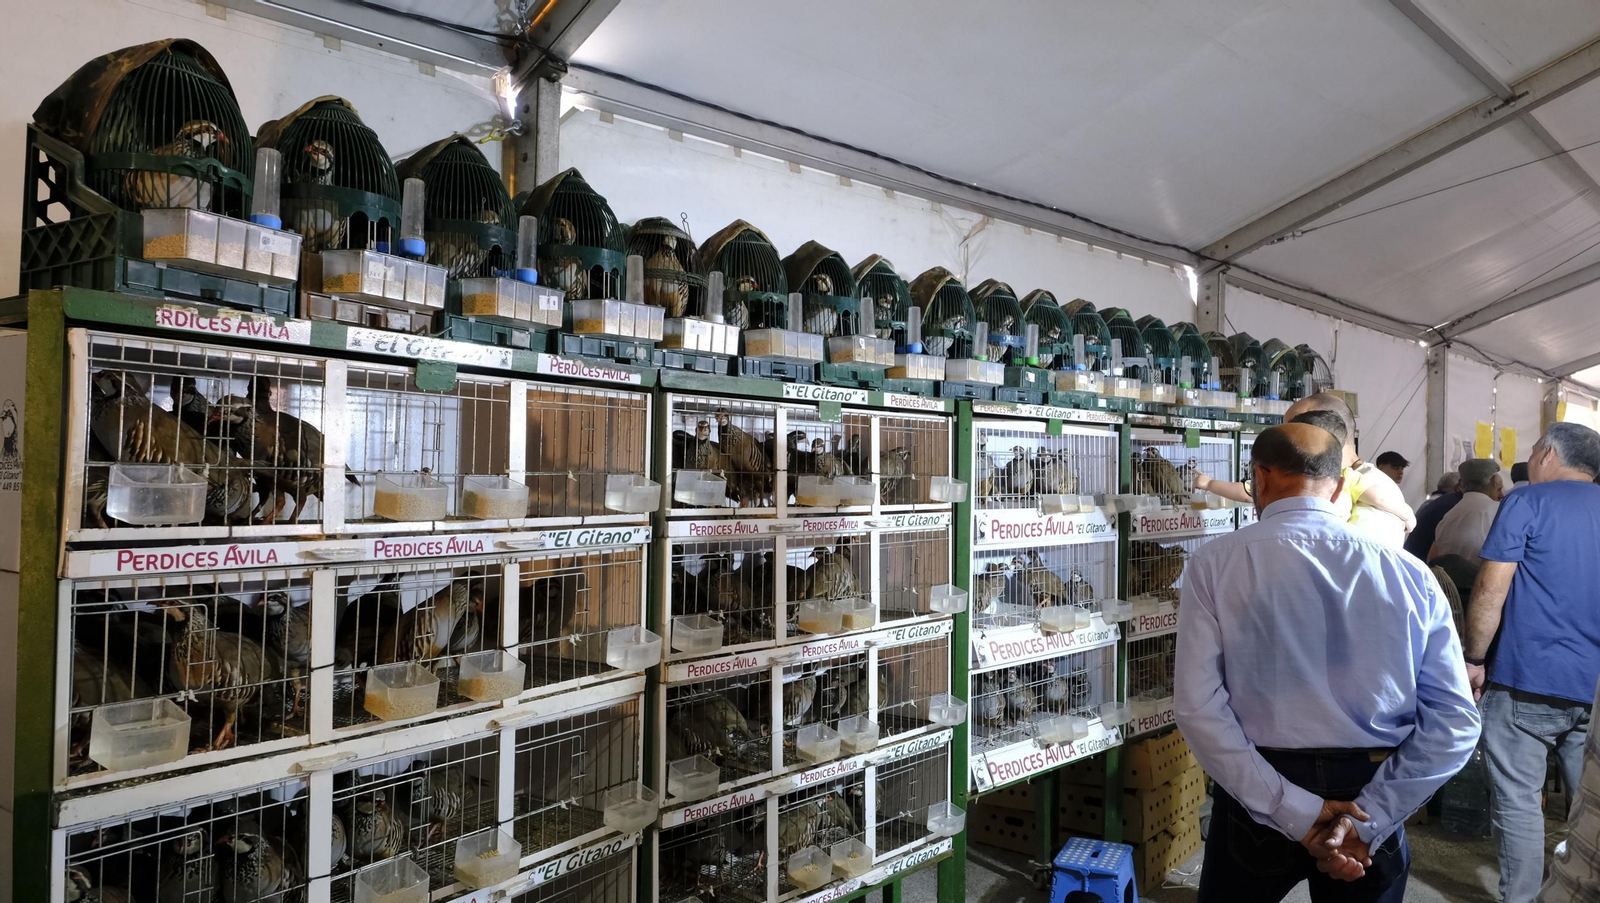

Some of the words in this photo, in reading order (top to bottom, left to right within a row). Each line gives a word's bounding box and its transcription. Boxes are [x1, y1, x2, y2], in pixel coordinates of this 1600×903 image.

[549, 356, 600, 378] PERDICES
[791, 385, 809, 399] "El
[812, 387, 858, 402] Gitano"
[890, 394, 920, 409] PERDICES
[1032, 405, 1044, 417] "El
[1045, 407, 1076, 420] Gitano"
[1184, 419, 1206, 429] Gitano"
[689, 521, 733, 536] PERDICES
[734, 520, 759, 534] ÁVILA
[802, 519, 838, 532] PERDICES
[838, 517, 859, 530] ÁVILA
[891, 515, 906, 527] "El
[907, 513, 945, 527] Gitano"
[991, 518, 1043, 540] PERDICES
[1044, 515, 1074, 536] ÁVILA
[1075, 523, 1085, 535] "El
[1085, 521, 1109, 534] Gitano"
[1140, 515, 1179, 534] PERDICES
[1180, 512, 1202, 529] ÁVILA
[1209, 516, 1229, 528] Gitano"
[373, 538, 443, 559] PERDICES
[445, 535, 485, 554] ÁVILA
[548, 529, 572, 548] "El
[576, 527, 640, 546] Gitano"
[116, 548, 219, 572] PERDICES
[223, 544, 279, 566] ÁVILA
[891, 628, 906, 641] "El
[908, 621, 946, 639] Gitano"
[1139, 612, 1178, 632] PERDICES
[802, 643, 838, 658] PERDICES
[838, 637, 859, 651] ÁVILA
[988, 637, 1045, 662] PERDICES
[1076, 633, 1087, 645] "El
[1087, 628, 1112, 643] Gitano"
[687, 659, 731, 678] PERDICES
[732, 655, 759, 670] ÁVILA
[890, 744, 906, 758] "El
[907, 731, 946, 754] Gitano"
[987, 752, 1045, 783] PERDICES
[1076, 743, 1087, 755] "El
[1088, 734, 1112, 752] Gitano"
[800, 765, 836, 785] PERDICES
[837, 760, 858, 774] ÁVILA
[683, 800, 728, 822] PERDICES
[729, 793, 756, 809] ÁVILA
[537, 863, 560, 881] "El
[566, 836, 631, 873] Gitano"
[889, 859, 904, 875] "El
[905, 842, 945, 868] Gitano"
